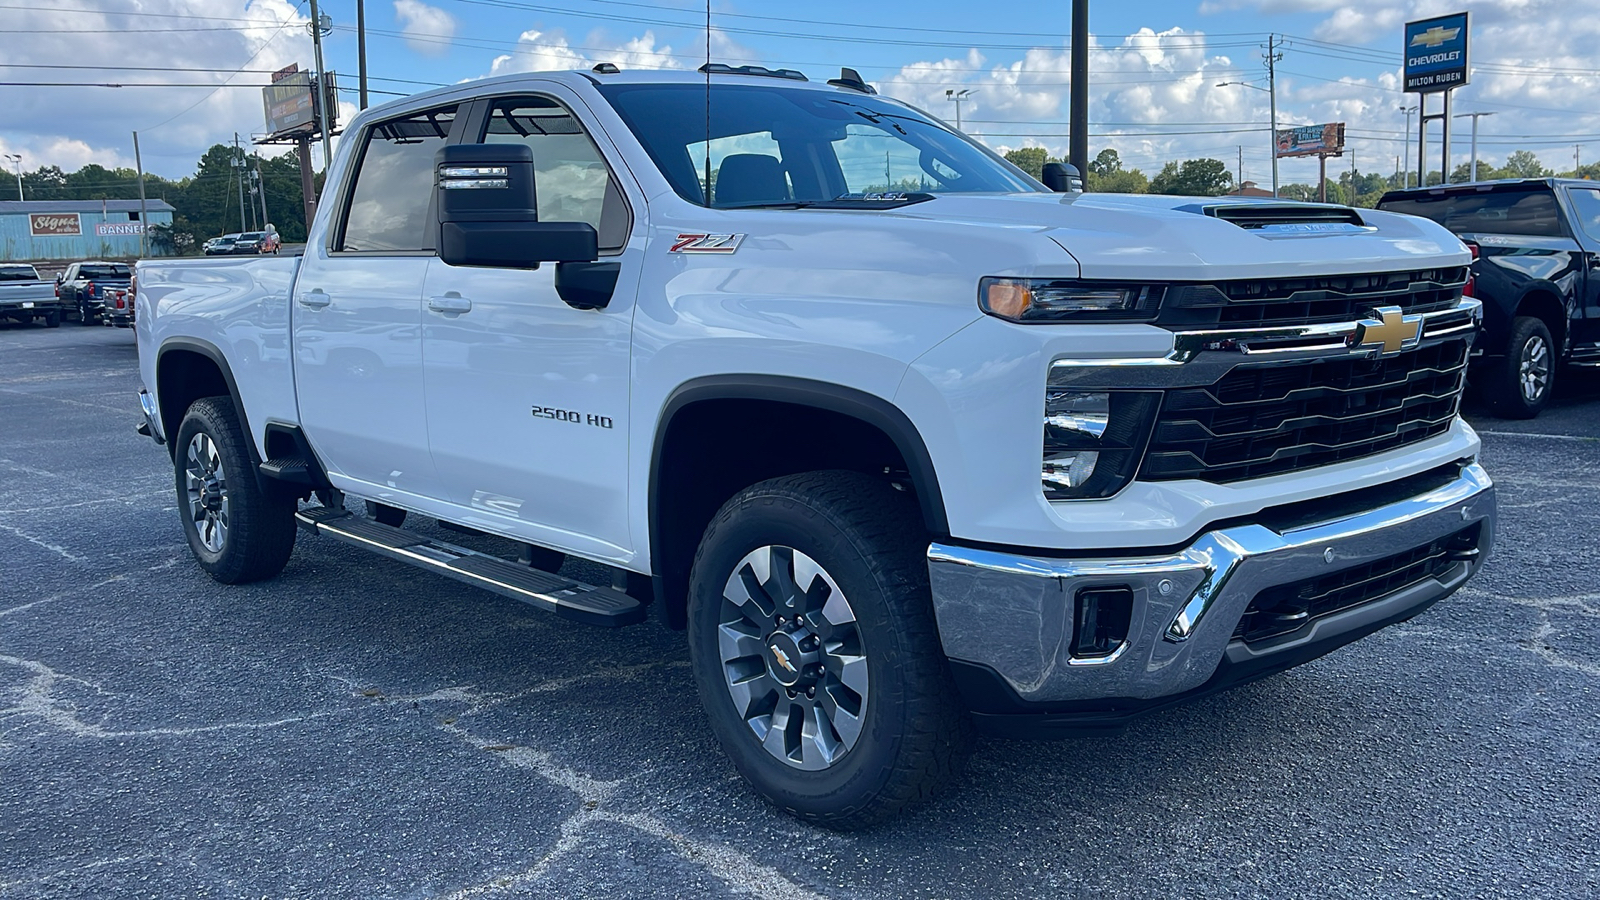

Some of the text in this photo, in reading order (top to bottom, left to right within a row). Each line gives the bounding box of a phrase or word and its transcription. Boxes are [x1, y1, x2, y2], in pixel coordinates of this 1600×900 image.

[1408, 50, 1461, 67] CHEVROLET
[1408, 72, 1461, 87] MILTON RUBEN
[34, 216, 76, 230] Signs
[667, 233, 748, 255] Z71
[531, 405, 613, 429] 2500 HD
